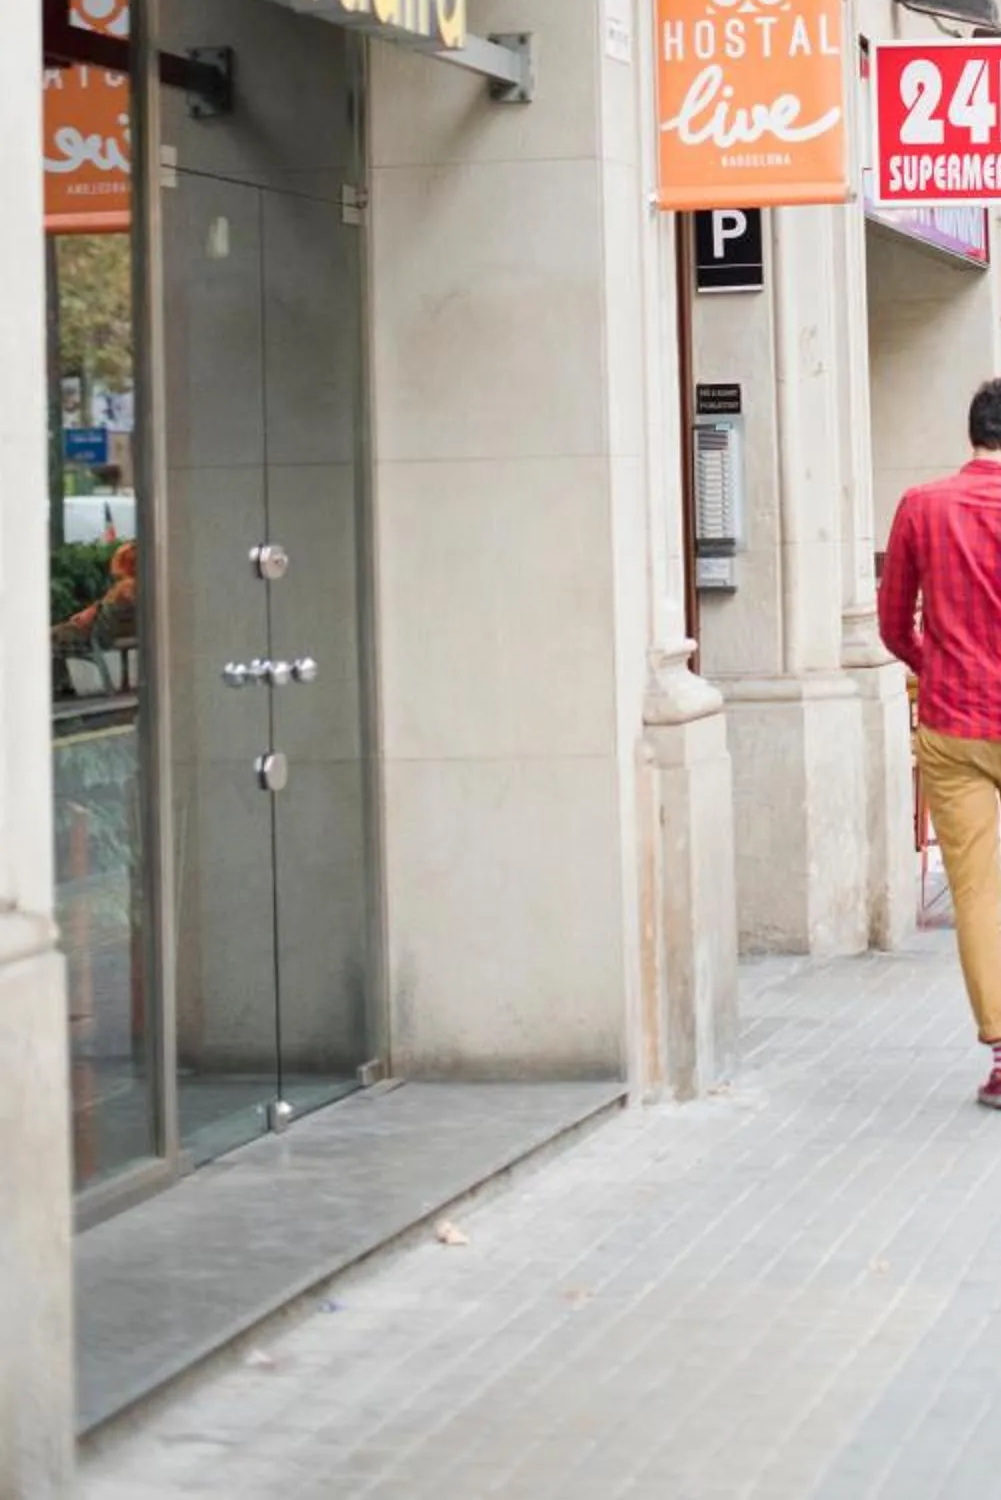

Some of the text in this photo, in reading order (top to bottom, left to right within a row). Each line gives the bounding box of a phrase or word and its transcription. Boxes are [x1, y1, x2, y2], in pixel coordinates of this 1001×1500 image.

[663, 13, 841, 62] HOSTAL
[660, 64, 842, 149] live
[712, 208, 748, 259] P
